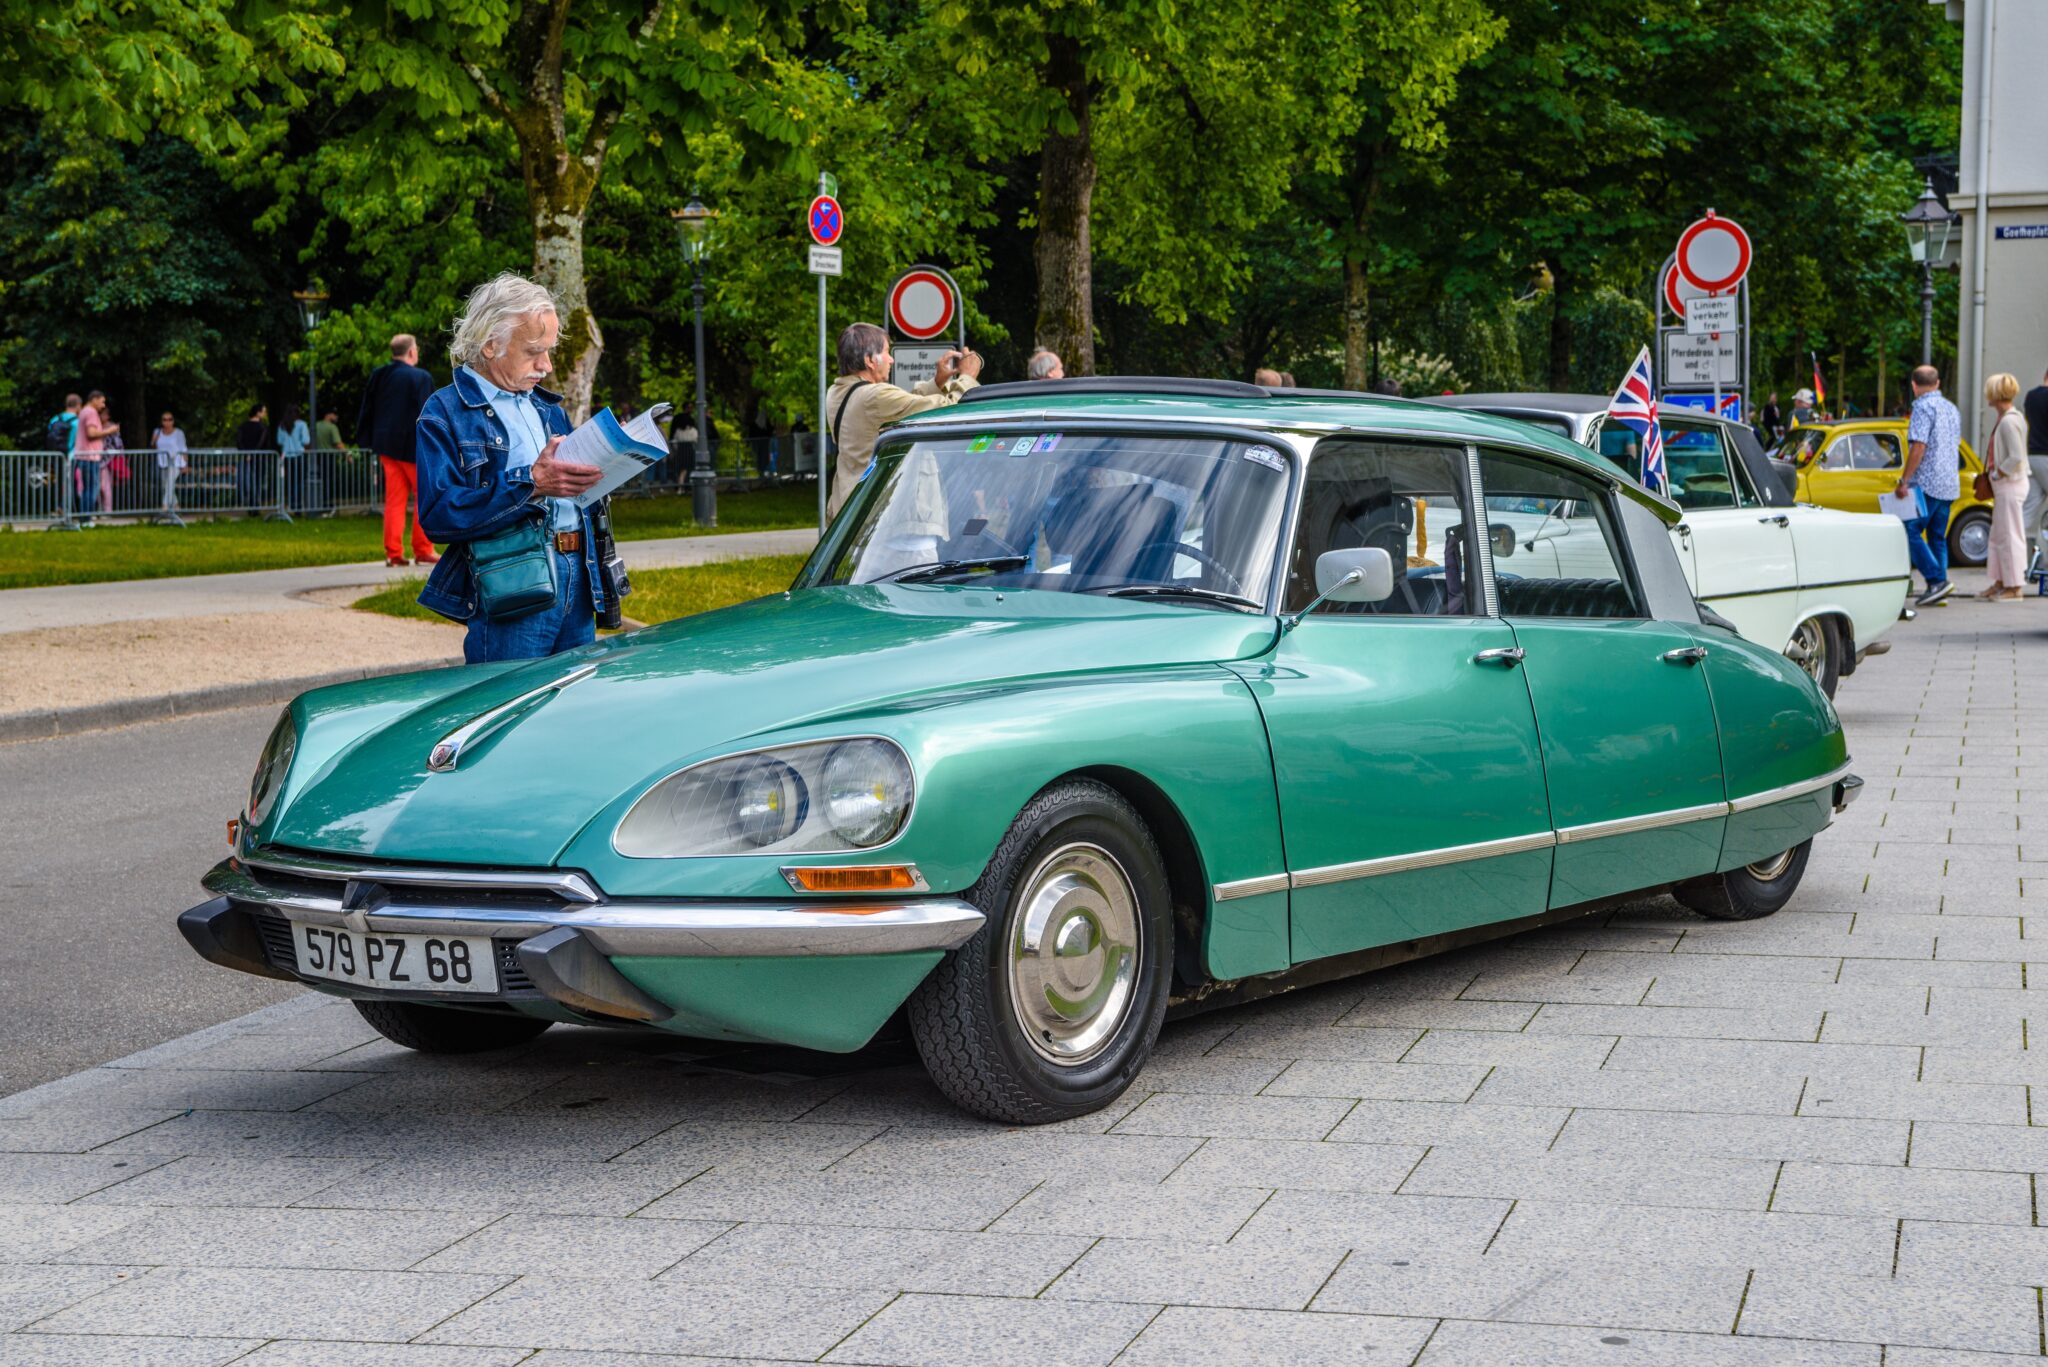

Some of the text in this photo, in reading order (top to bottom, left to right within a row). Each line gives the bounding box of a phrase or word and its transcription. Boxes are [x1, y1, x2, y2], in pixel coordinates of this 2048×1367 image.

[1694, 302, 1727, 310] Linien-
[1693, 311, 1729, 320] verkehr
[1703, 322, 1720, 330] frei
[1696, 336, 1708, 345] für
[918, 351, 929, 360] für
[1671, 348, 1733, 358] Pferdedroscken
[1685, 360, 1699, 369] und
[1694, 372, 1711, 380] frei
[305, 927, 473, 984] 579 PZ 68
